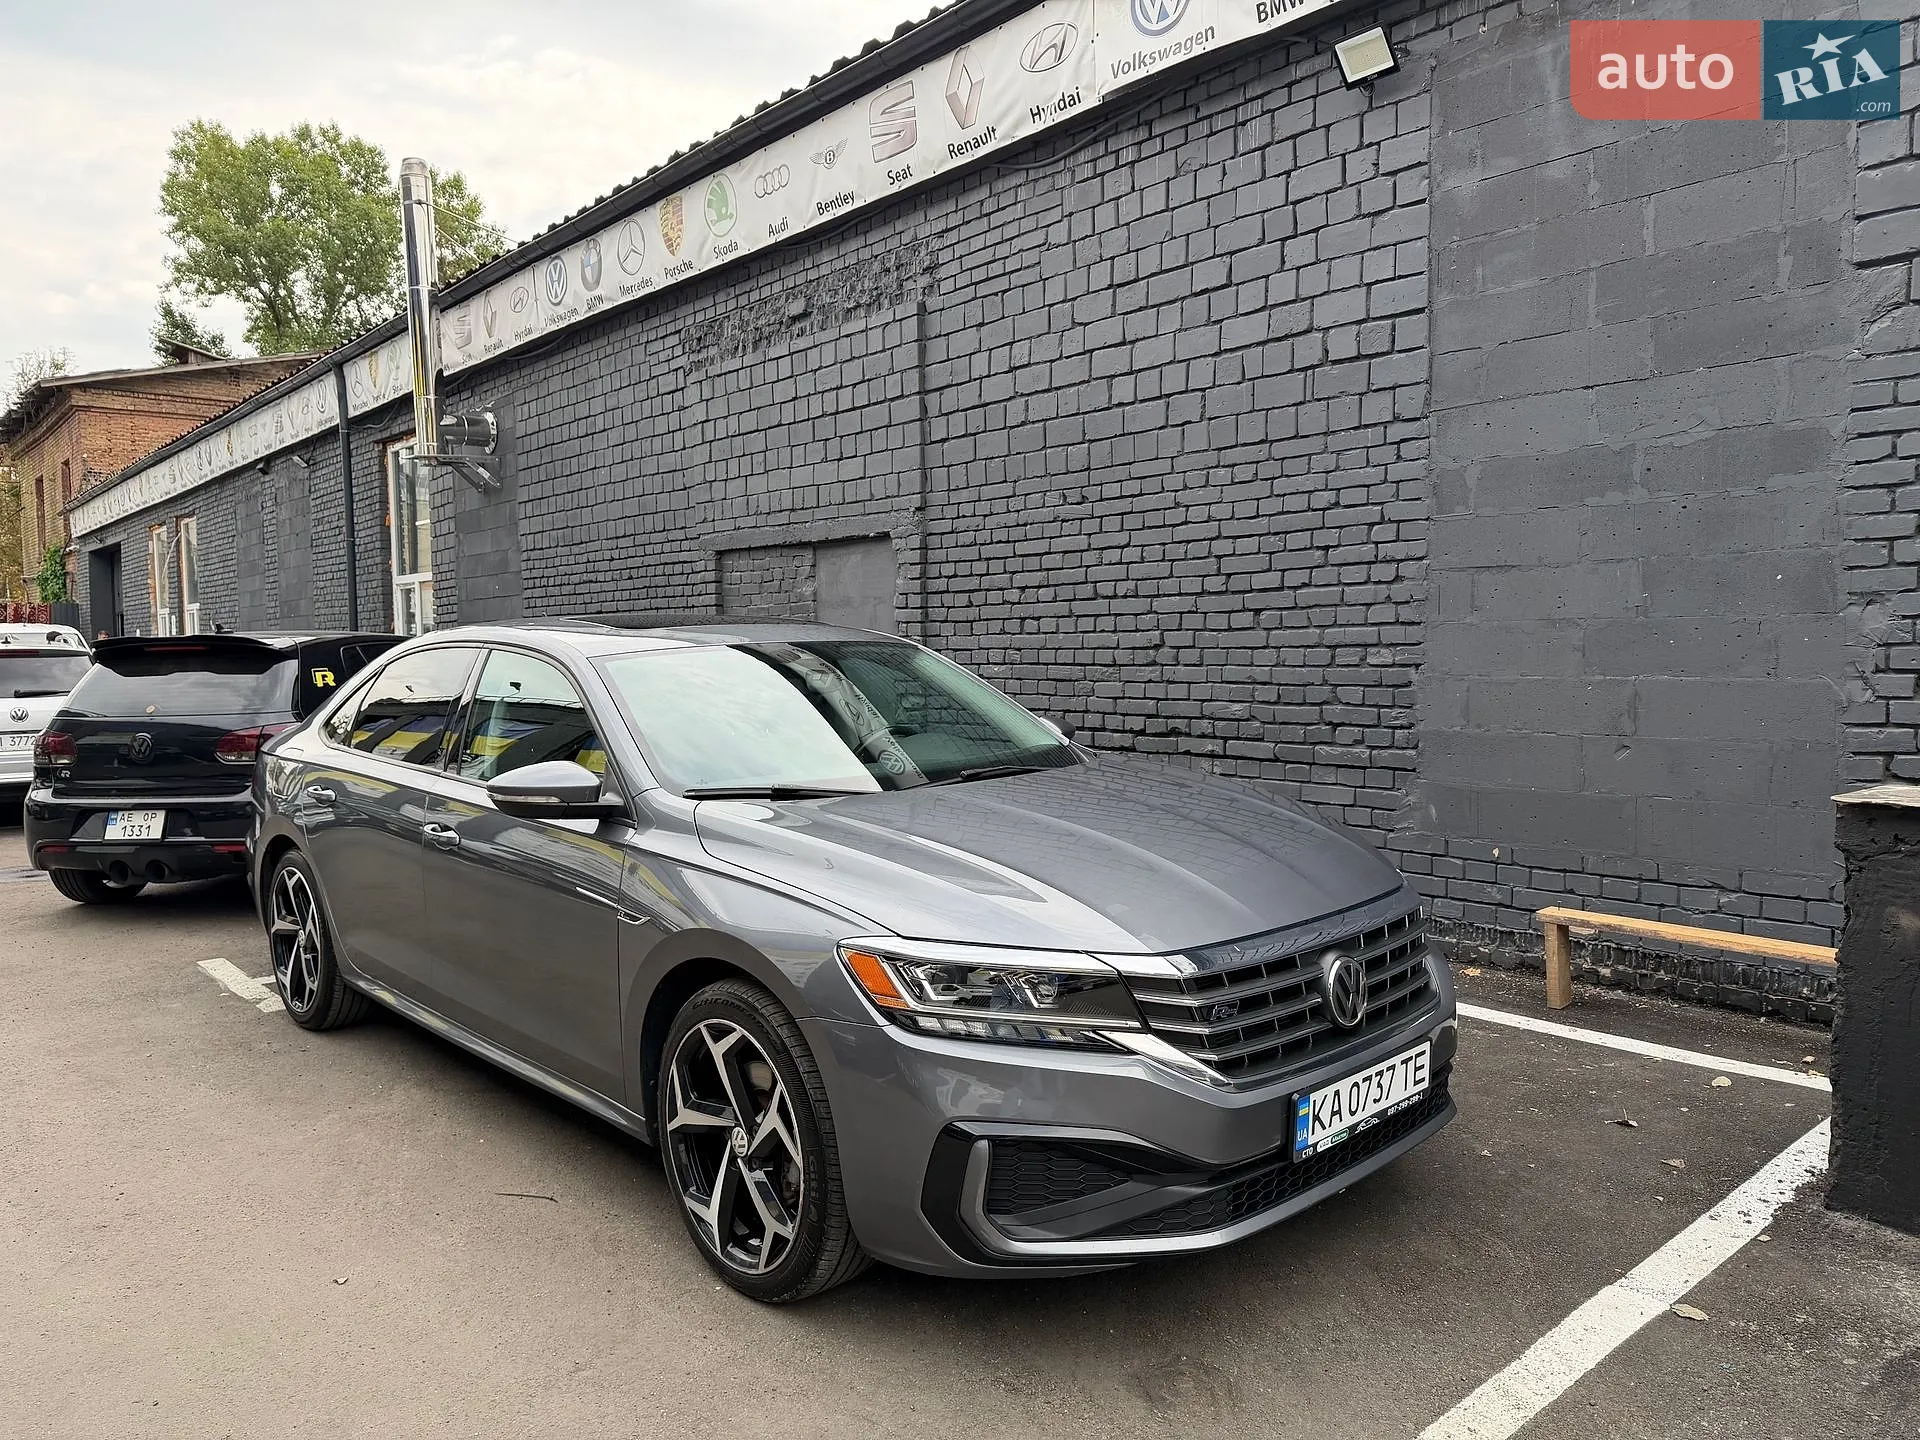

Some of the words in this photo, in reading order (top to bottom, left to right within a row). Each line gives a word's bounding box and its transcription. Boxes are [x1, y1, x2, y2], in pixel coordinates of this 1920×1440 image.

[1110, 22, 1215, 80] Volkswagen
[947, 126, 998, 160] Renault
[887, 163, 913, 187] Seat
[816, 190, 855, 216] Bentley
[768, 216, 789, 238] Audi
[713, 240, 739, 260] Skoda
[664, 258, 694, 280] Porsche
[619, 276, 653, 298] Mercedes
[586, 294, 604, 311] BMW
[544, 307, 580, 328] Volkswagen
[315, 671, 337, 688] R
[119, 812, 134, 822] AE
[121, 825, 151, 837] 1331
[1310, 1088, 1342, 1136] KA
[1349, 1063, 1396, 1117] 0737
[1400, 1049, 1426, 1092] TE
[1297, 1128, 1308, 1141] UA
